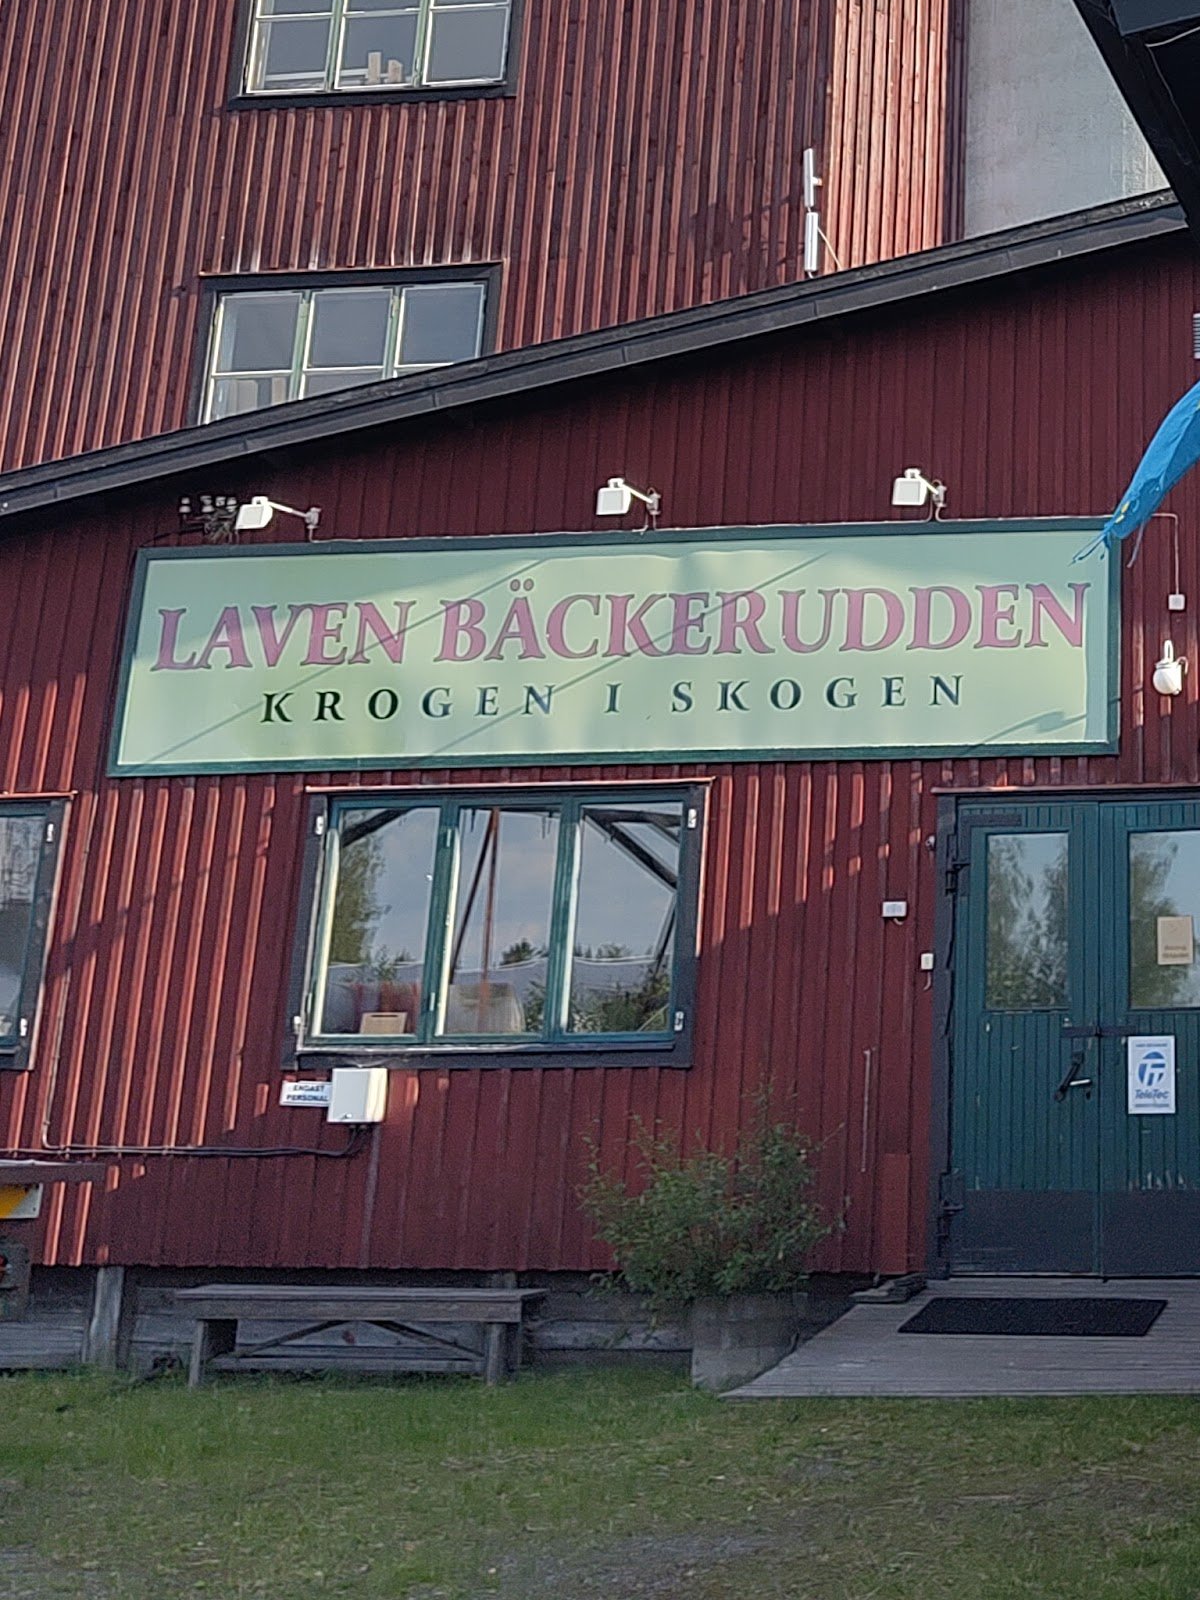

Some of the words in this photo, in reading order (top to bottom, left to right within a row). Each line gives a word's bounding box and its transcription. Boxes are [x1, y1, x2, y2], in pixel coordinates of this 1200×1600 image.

[150, 600, 416, 672] LAVEN
[433, 578, 1091, 663] BÄCKERUDDEN
[260, 683, 556, 724] KROGEN
[603, 682, 622, 714] I
[671, 674, 964, 713] SKOGEN
